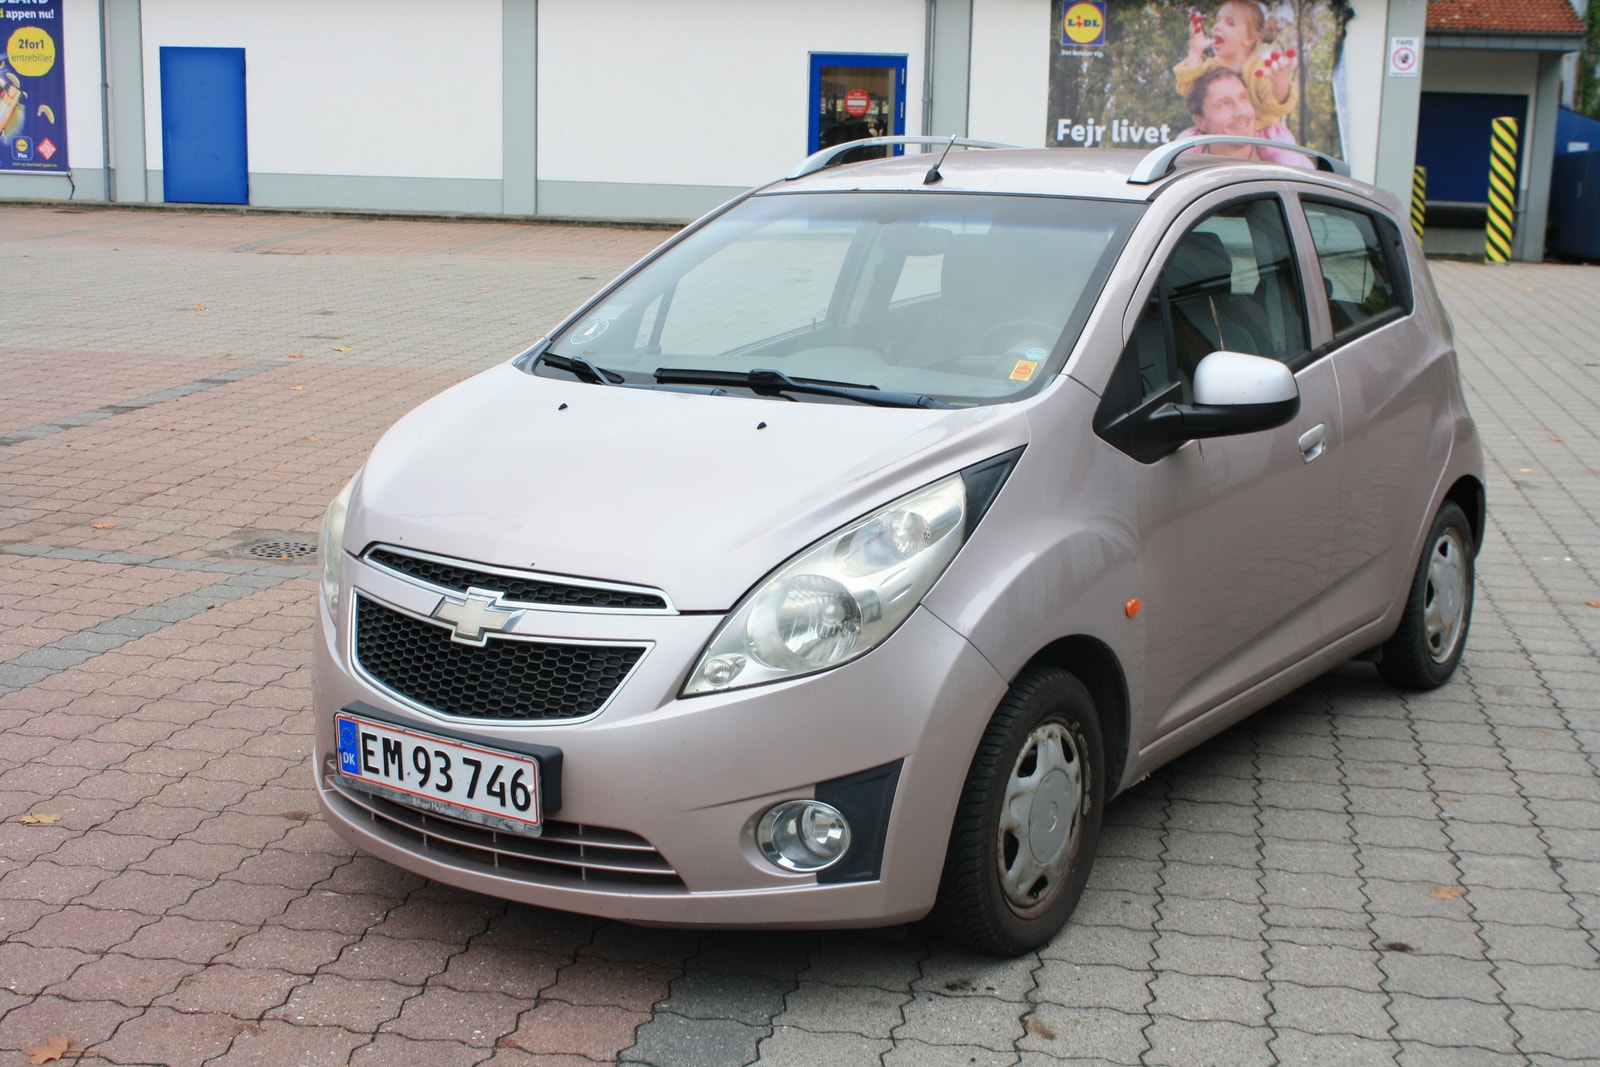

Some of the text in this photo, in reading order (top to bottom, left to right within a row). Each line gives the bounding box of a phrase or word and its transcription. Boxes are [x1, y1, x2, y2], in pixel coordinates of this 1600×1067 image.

[5, 10, 37, 21] appen
[38, 9, 55, 19] nu!
[11, 54, 53, 63] entrebillet
[1056, 118, 1171, 148] Fejr livet
[342, 751, 356, 766] DK
[361, 731, 404, 782] EM
[412, 745, 453, 793] 93
[462, 756, 532, 812] 746
